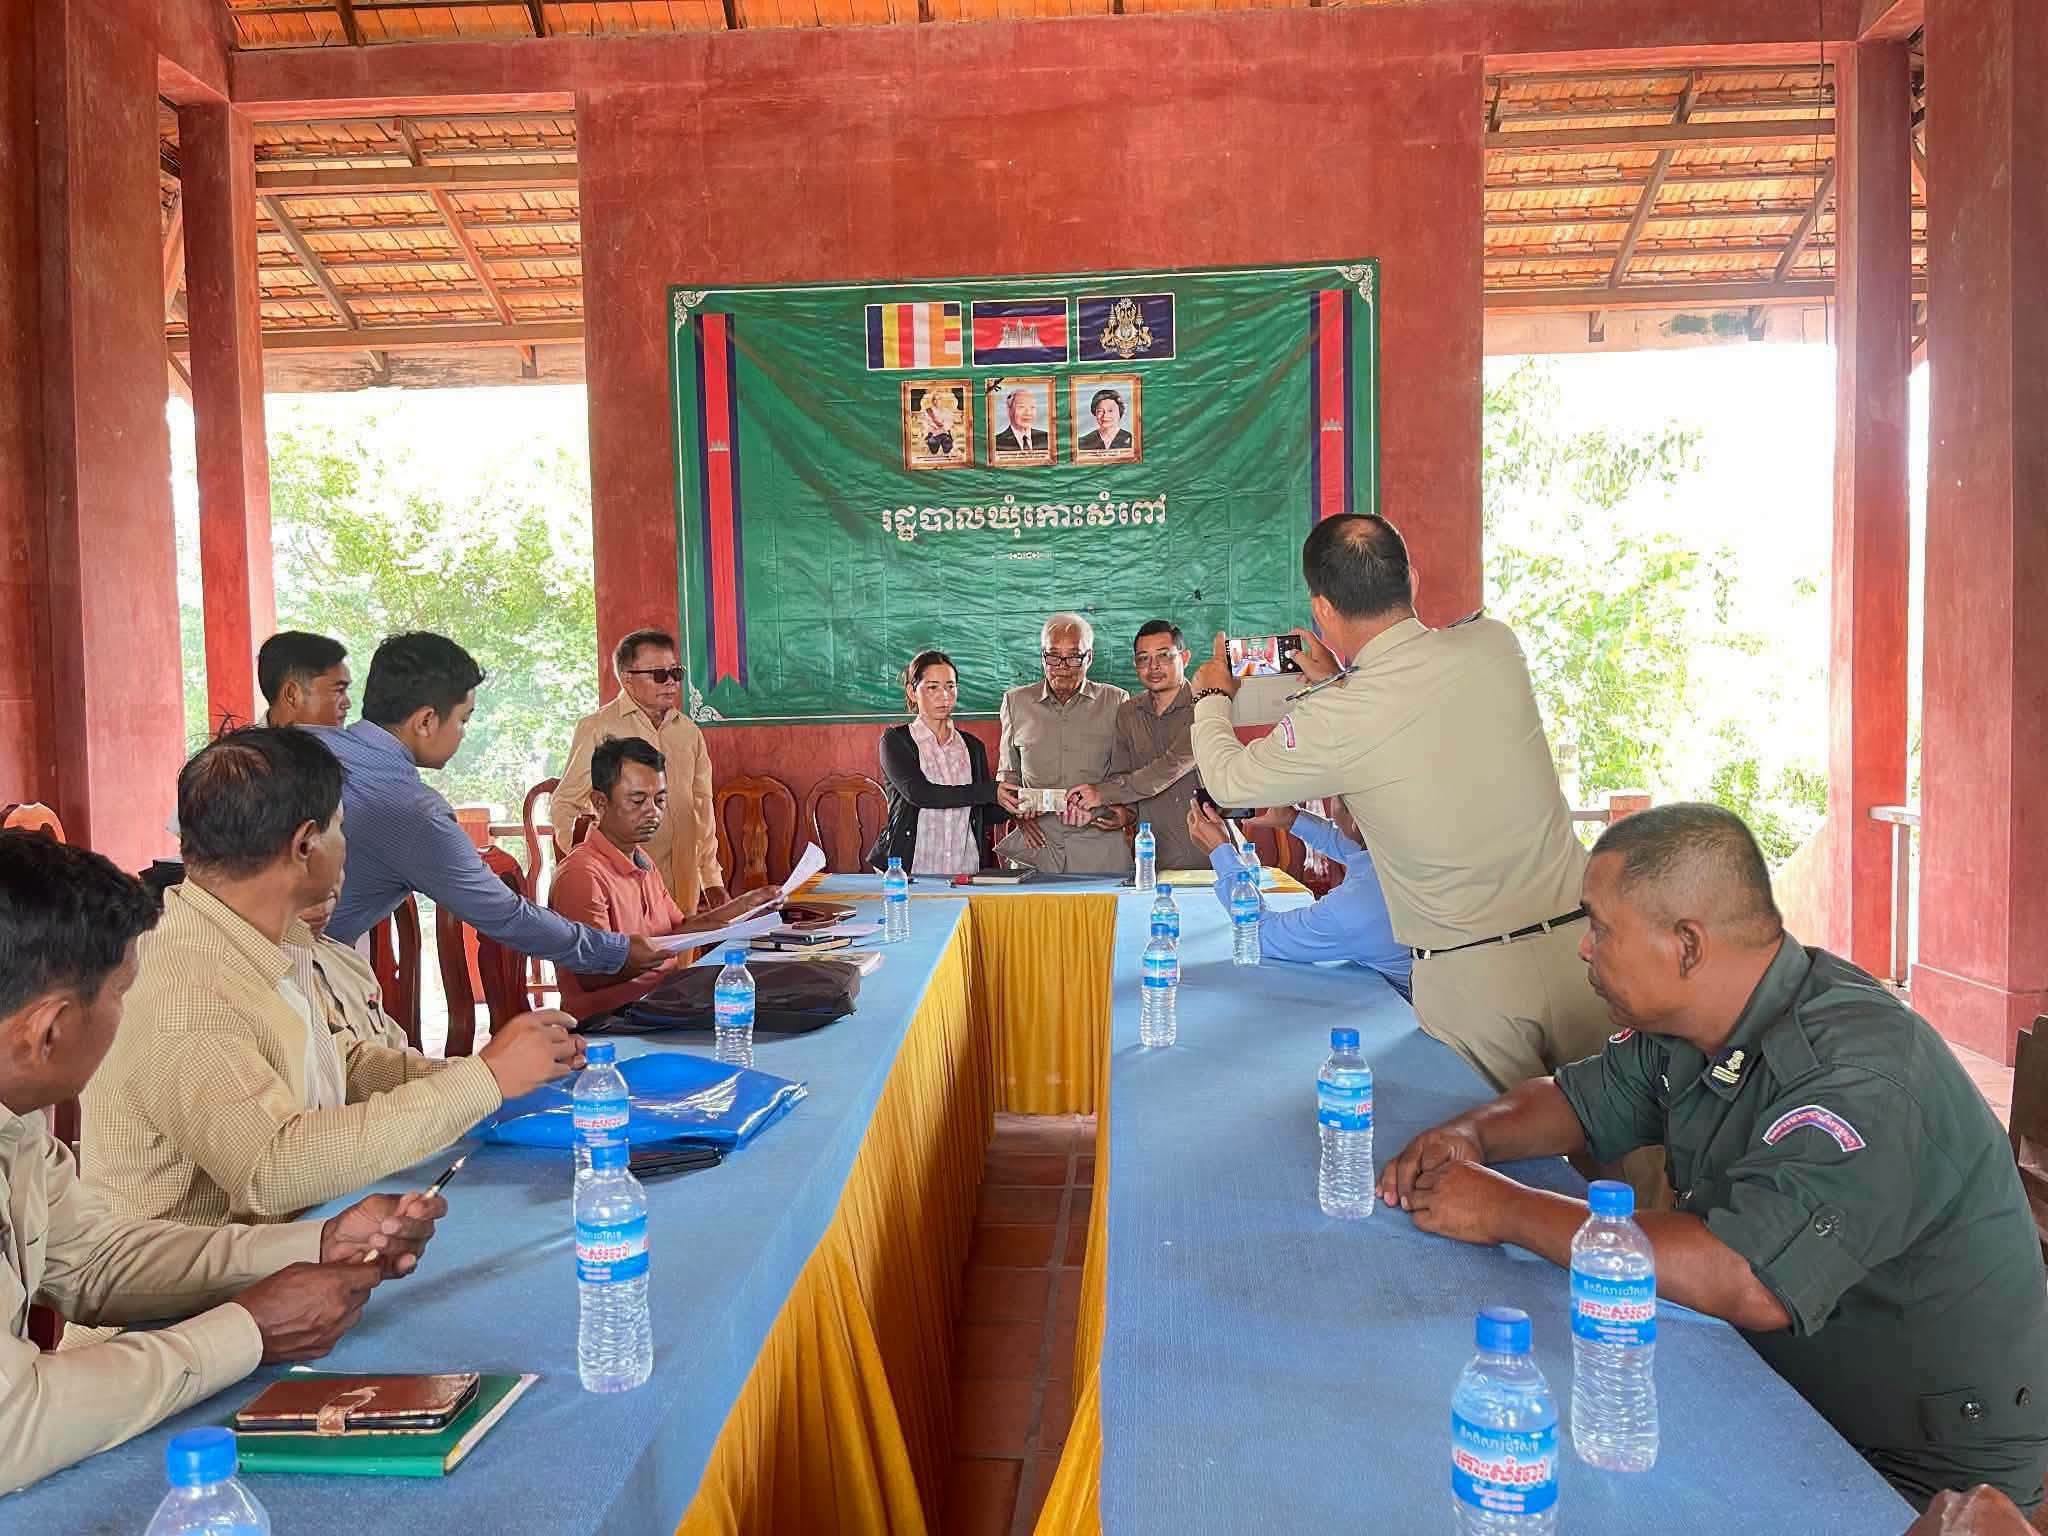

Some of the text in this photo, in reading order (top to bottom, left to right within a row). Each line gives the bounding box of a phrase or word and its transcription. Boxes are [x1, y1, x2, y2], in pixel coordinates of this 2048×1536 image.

[882, 492, 1167, 541] រដ្ឋបាលឃុំកោះសំពៅ
